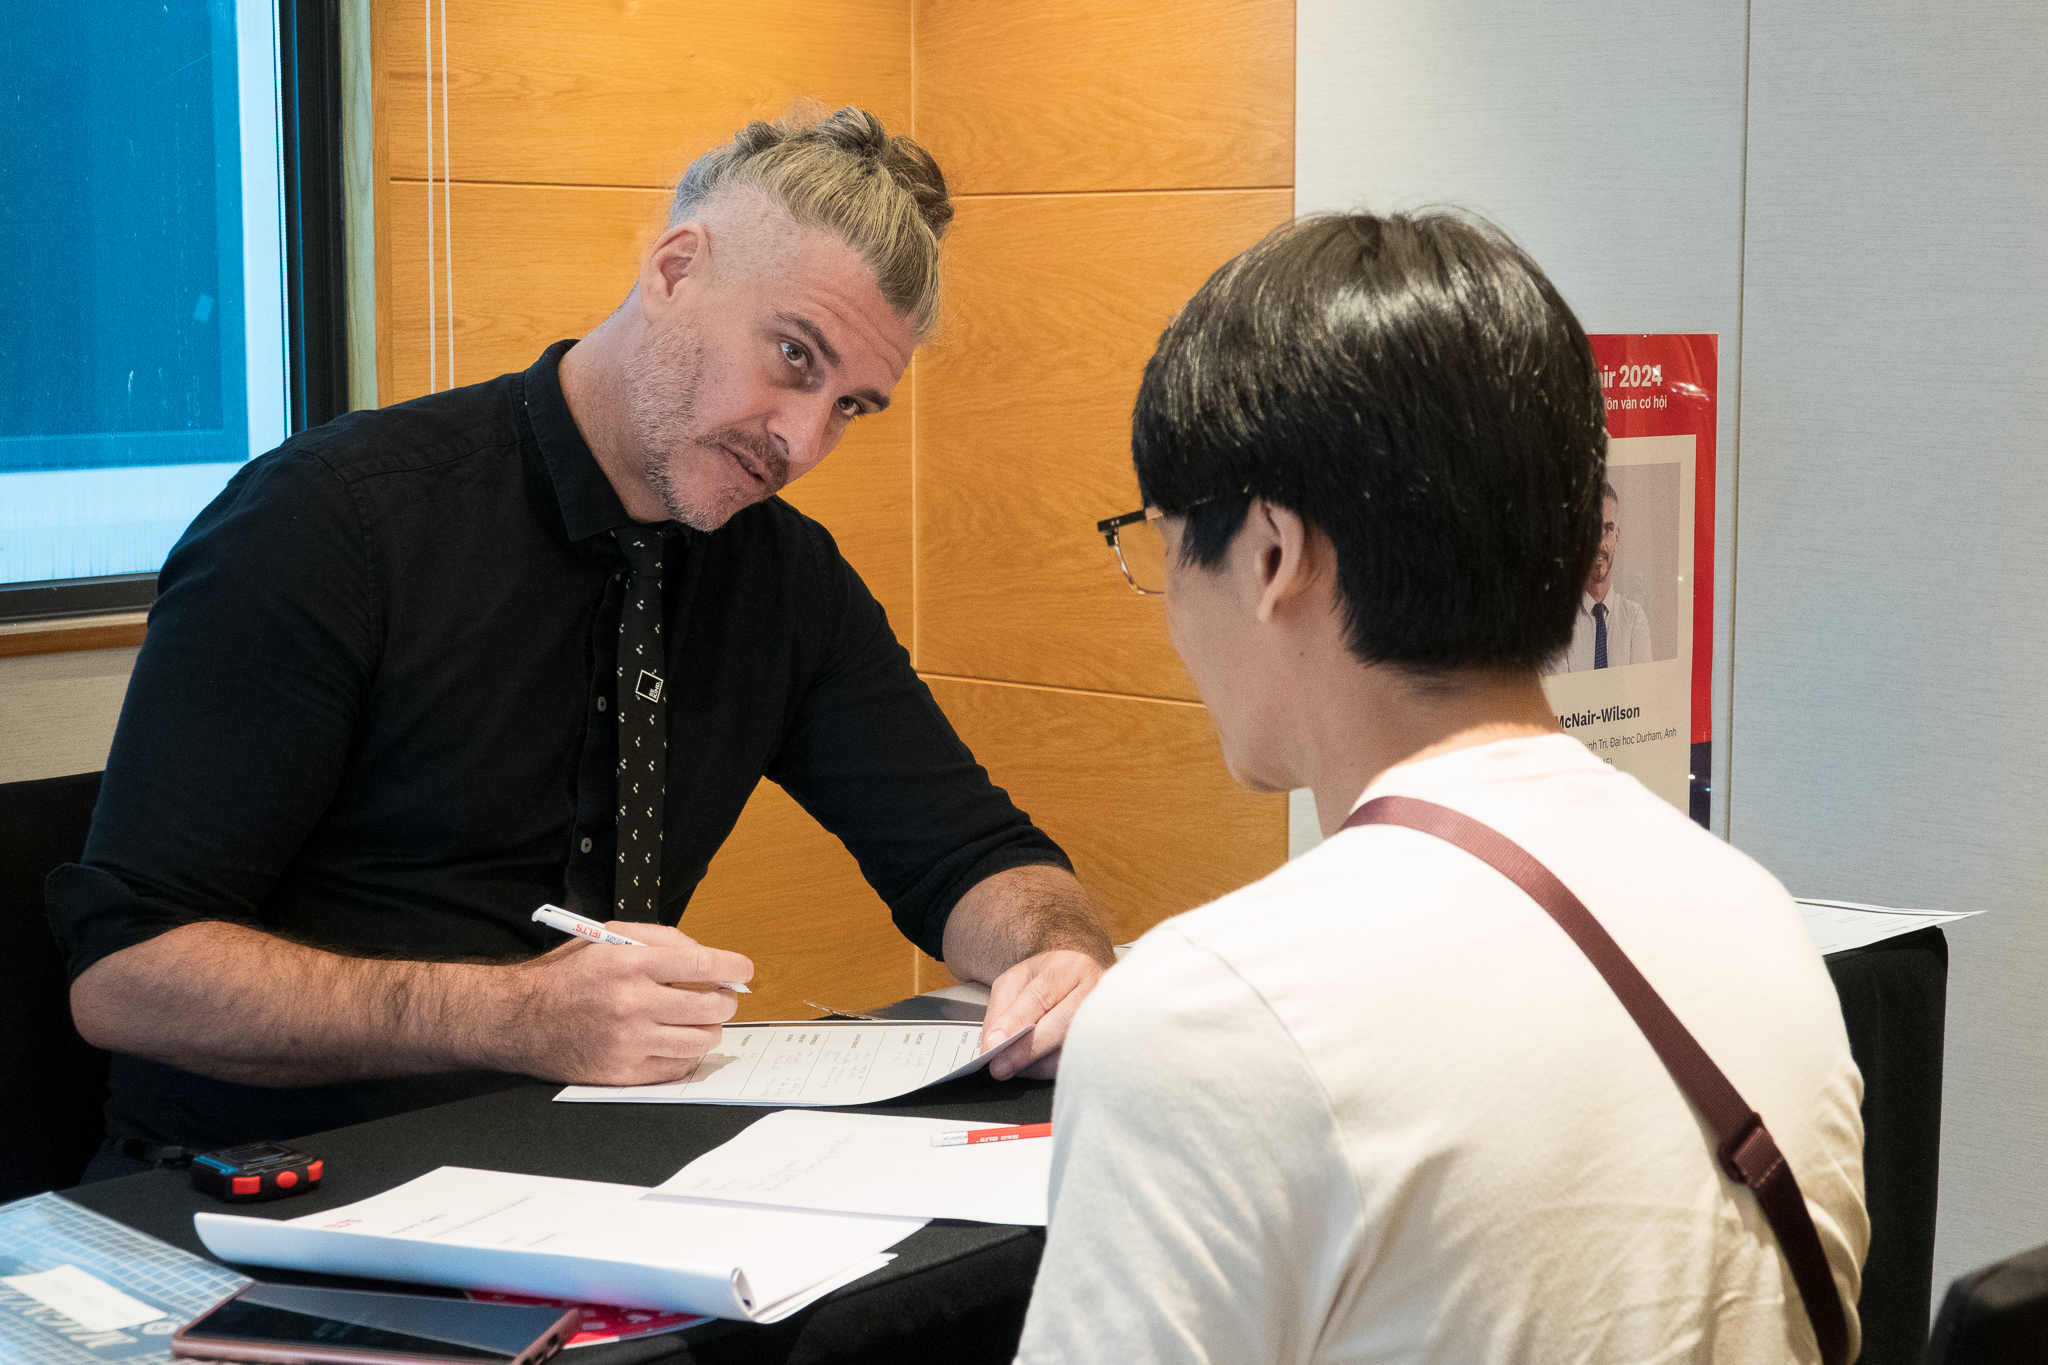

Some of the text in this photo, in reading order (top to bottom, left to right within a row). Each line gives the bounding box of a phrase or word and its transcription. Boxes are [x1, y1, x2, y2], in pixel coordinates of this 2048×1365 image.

[1619, 364, 1663, 388] 2024
[1621, 396, 1637, 409] vàn
[1653, 395, 1668, 411] hội
[1664, 727, 1677, 739] Anh
[575, 923, 602, 939] IELTS
